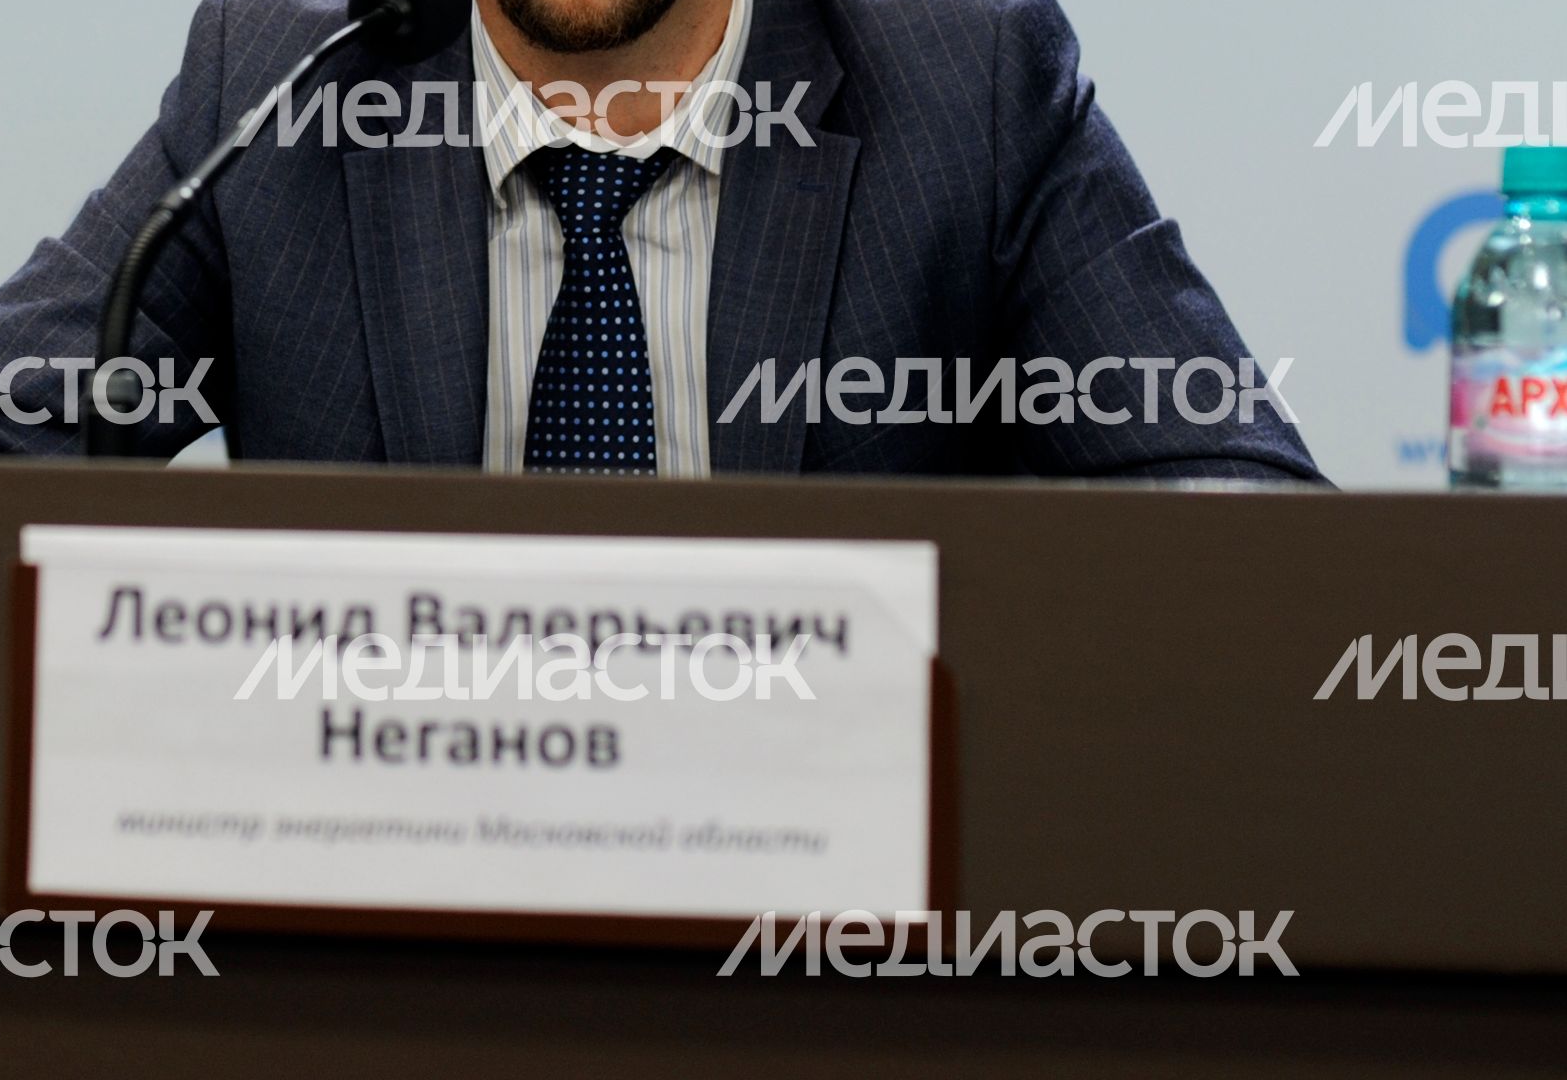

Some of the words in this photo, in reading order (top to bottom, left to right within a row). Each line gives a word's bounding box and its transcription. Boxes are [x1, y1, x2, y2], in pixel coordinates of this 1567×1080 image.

[97, 586, 384, 657] Леонид
[404, 592, 852, 665] Валерьевич
[318, 708, 624, 770] Неганов
